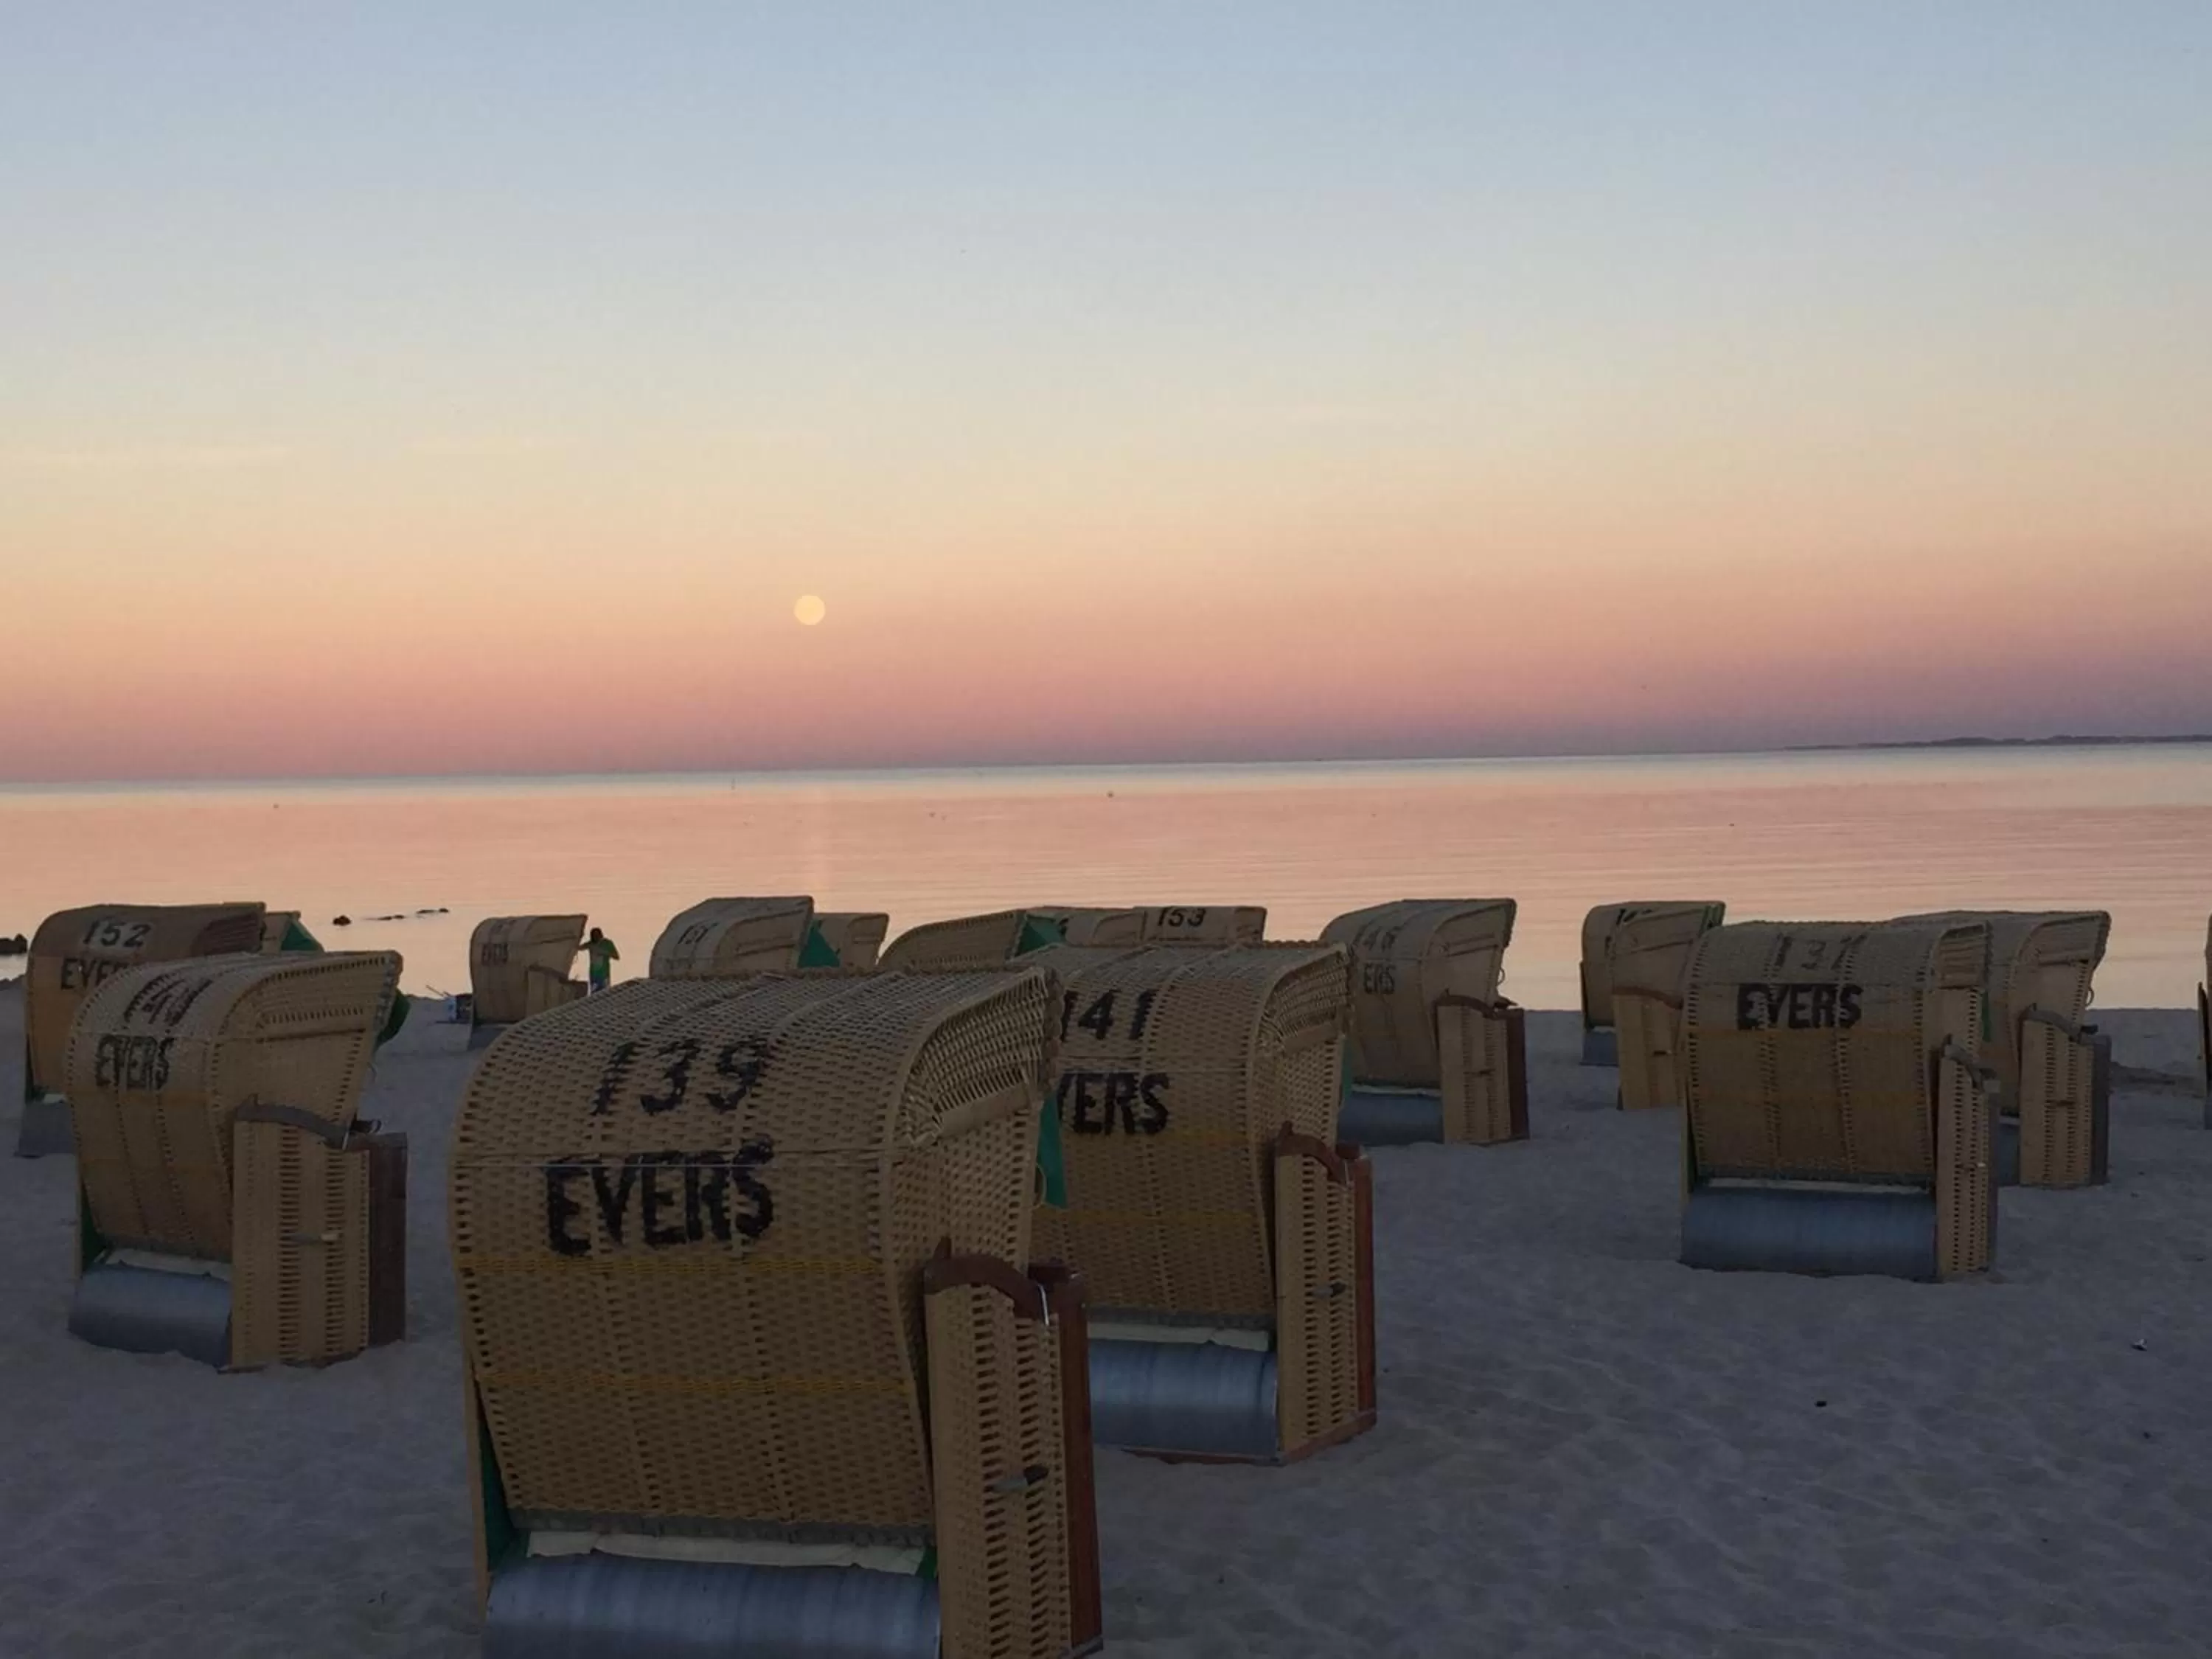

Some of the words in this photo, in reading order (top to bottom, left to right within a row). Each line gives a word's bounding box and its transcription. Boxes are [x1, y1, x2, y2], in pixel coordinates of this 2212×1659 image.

[83, 919, 152, 947] 152
[1158, 908, 1206, 927] 153
[61, 958, 130, 990] EVE
[1060, 990, 1158, 1042] 141
[1738, 983, 1864, 1030] EVERS
[591, 1037, 770, 1116] 139
[1057, 1072, 1169, 1135] VERS
[544, 1133, 774, 1256] EVERS
